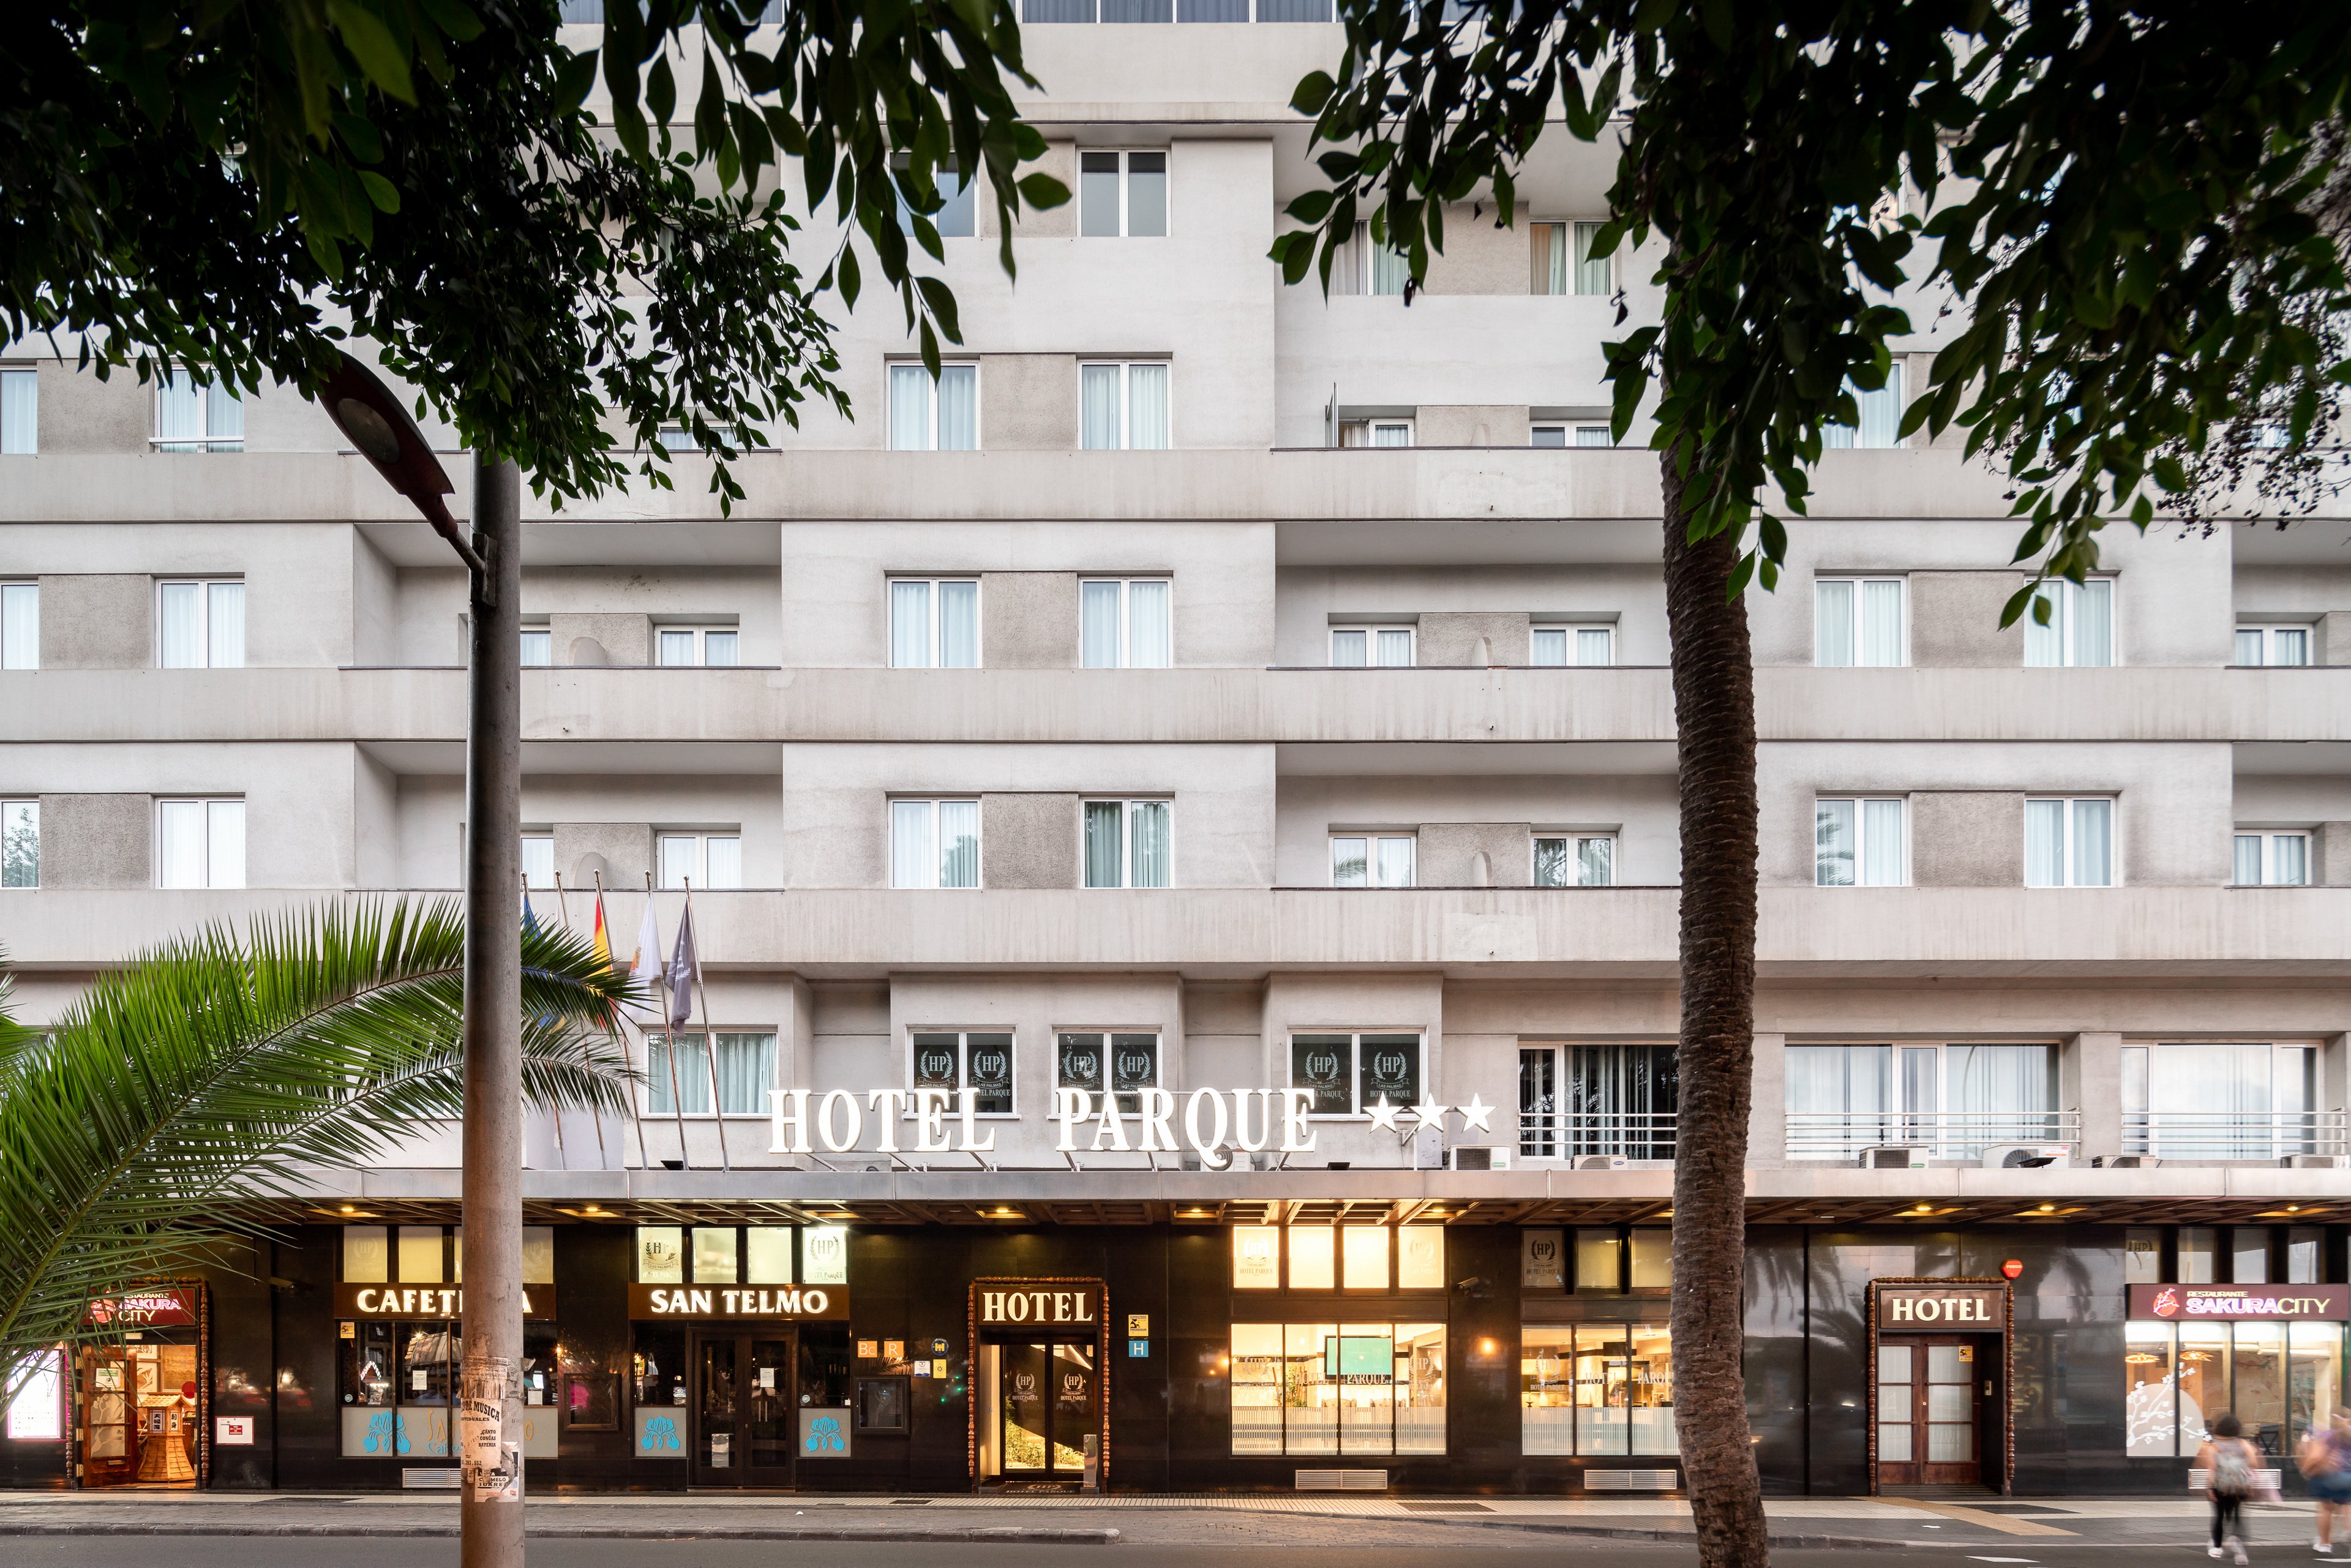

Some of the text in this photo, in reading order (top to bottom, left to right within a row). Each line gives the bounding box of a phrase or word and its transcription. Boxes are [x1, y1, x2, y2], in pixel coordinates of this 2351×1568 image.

[928, 1056, 947, 1071] HP
[981, 1056, 1001, 1071] HP
[1073, 1056, 1092, 1072] HP
[1127, 1056, 1145, 1072] HP
[1314, 1057, 1332, 1072] HP
[1382, 1057, 1401, 1072] HP
[989, 1089, 1010, 1098] PARQUE
[1320, 1090, 1342, 1099] PARQUE
[1389, 1090, 1411, 1099] PARQUE
[767, 1087, 1317, 1168] HOTEL PARQUE
[817, 1240, 834, 1255] HP
[1537, 1243, 1550, 1255] HP
[650, 1289, 829, 1315] SAN TELMO
[982, 1292, 1093, 1322] HOTEL
[1892, 1298, 1991, 1321] HOTEL
[118, 1310, 156, 1322] CITY
[888, 1343, 899, 1356] R
[1134, 1342, 1144, 1356] H
[1020, 1376, 1031, 1386] HP
[1068, 1376, 1079, 1386] HP
[1294, 1372, 1386, 1386] HOTEL PARQUE
[1585, 1371, 1674, 1387] HOTEL PARQU
[473, 1401, 500, 1422] MUSICA
